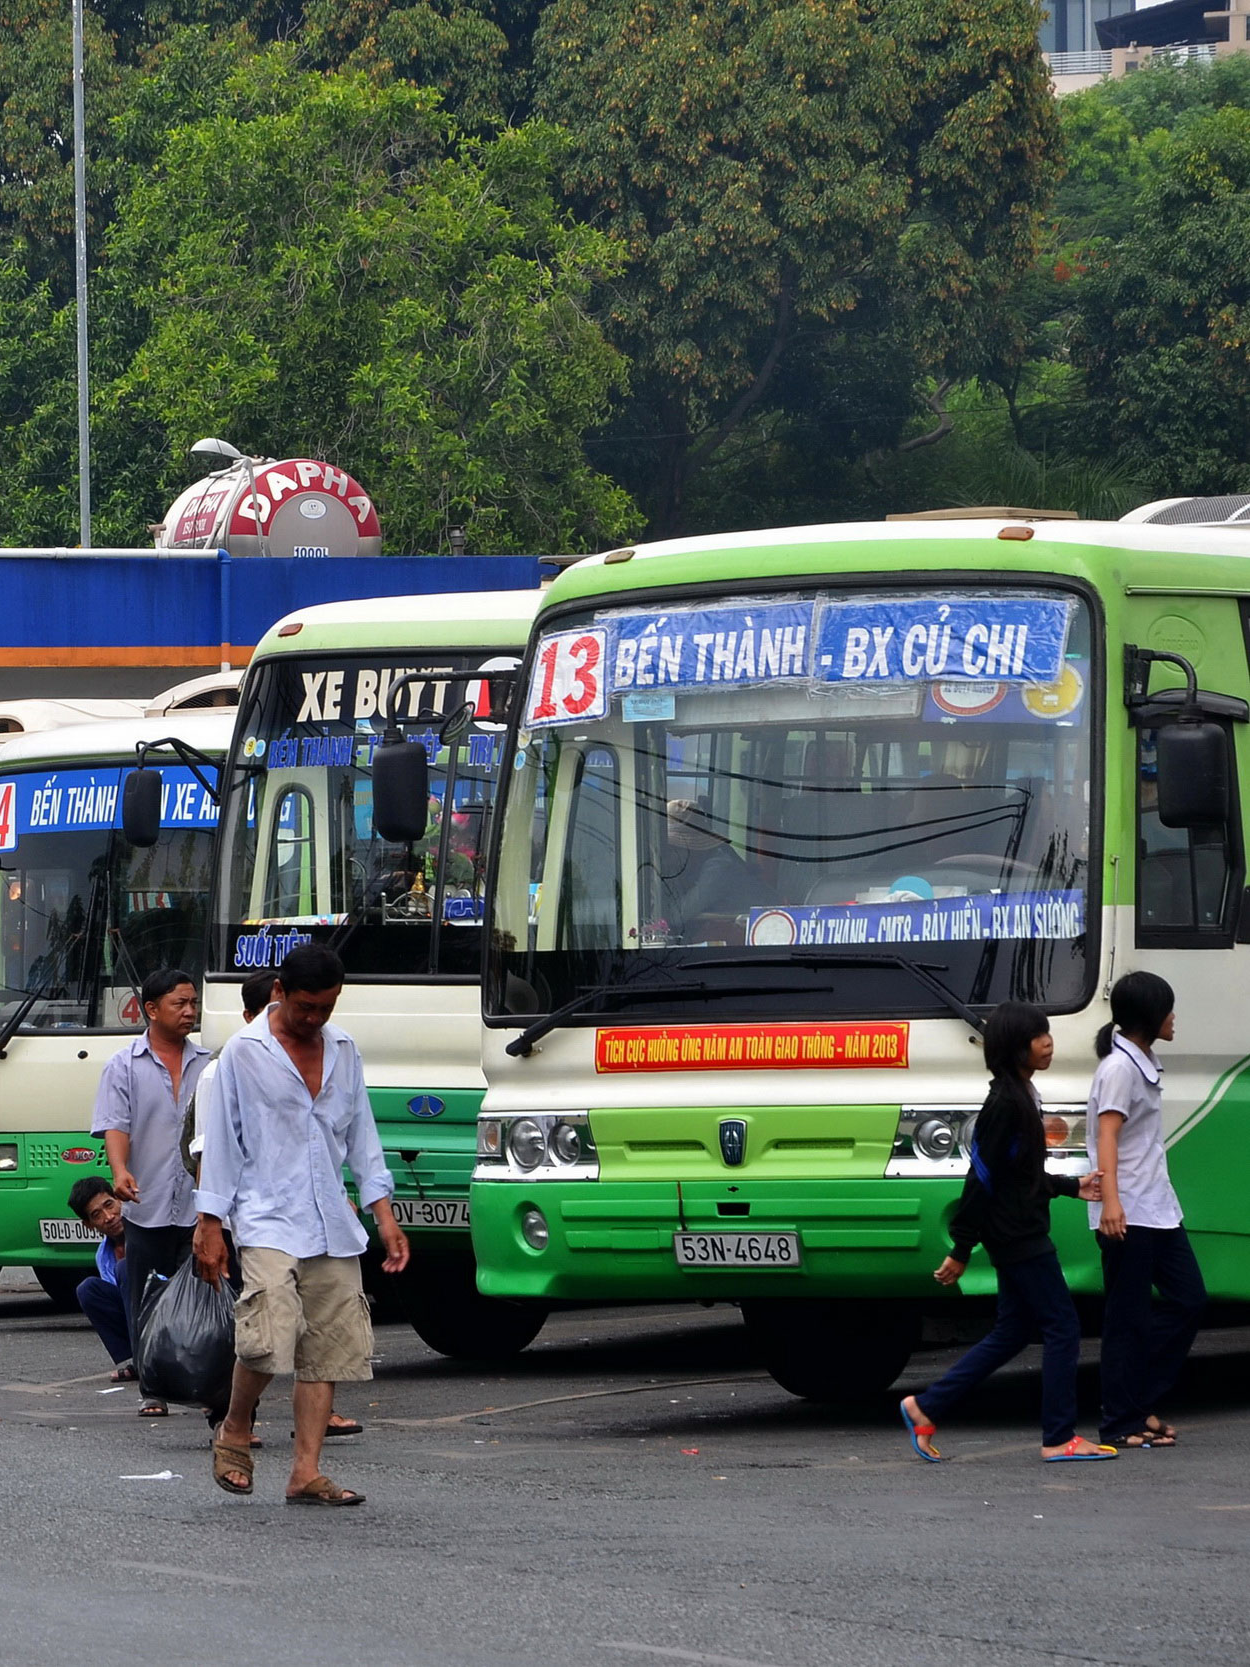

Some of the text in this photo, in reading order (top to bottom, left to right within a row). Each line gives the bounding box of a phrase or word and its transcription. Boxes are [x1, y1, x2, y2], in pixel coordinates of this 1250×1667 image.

[238, 462, 371, 523] DAPHA
[614, 617, 683, 688] BẾN
[694, 616, 806, 682] THÀNH
[842, 626, 894, 678] BX
[903, 604, 950, 676] CỦ
[961, 625, 1028, 676] CHI
[297, 670, 345, 722] XE
[533, 636, 600, 720] 13
[30, 775, 61, 827] BẾN
[66, 777, 118, 824] THÀNH
[172, 783, 197, 820] XE
[234, 924, 273, 967] SUỐI
[122, 996, 140, 1024] 4
[605, 1035, 624, 1063] TÍCH
[627, 1036, 645, 1068] CỰC
[703, 1033, 727, 1061] NĂM
[729, 1036, 743, 1060] AN
[746, 1031, 773, 1060] TOÀN
[774, 1036, 798, 1059] GIAO
[802, 1030, 835, 1059] THÔNG
[845, 1031, 870, 1058] NĂM
[872, 1034, 898, 1058] 2013
[391, 1203, 470, 1224] 0V-3074
[681, 1237, 791, 1262] 53N-4648
